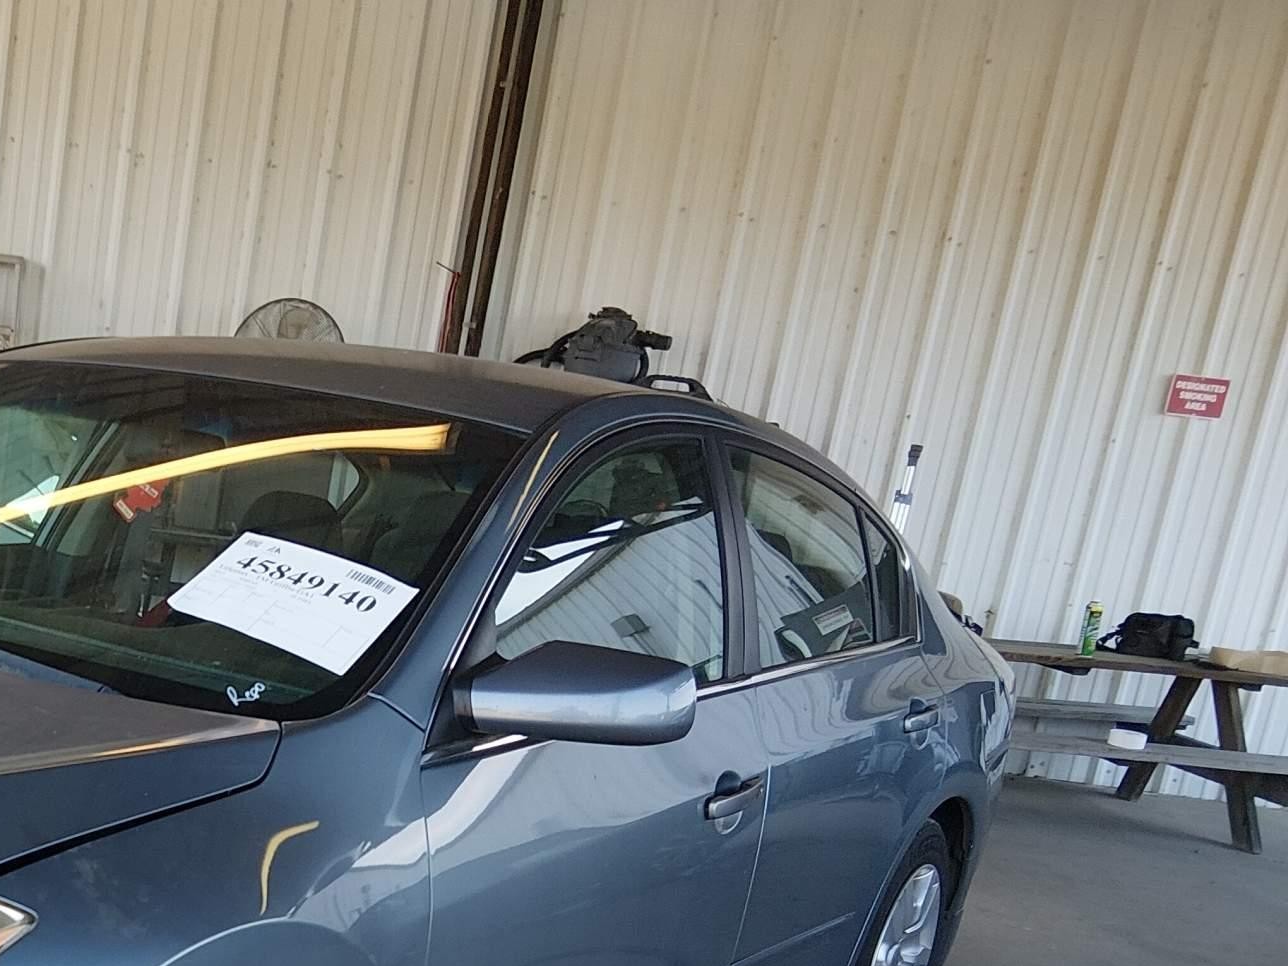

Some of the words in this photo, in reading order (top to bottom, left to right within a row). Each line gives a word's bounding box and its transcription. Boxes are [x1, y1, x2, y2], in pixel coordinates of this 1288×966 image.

[1175, 380, 1226, 394] DESIGNATED
[1178, 391, 1217, 403] SMOKING
[1184, 401, 1207, 411] AREA
[236, 555, 378, 613] 45849140
